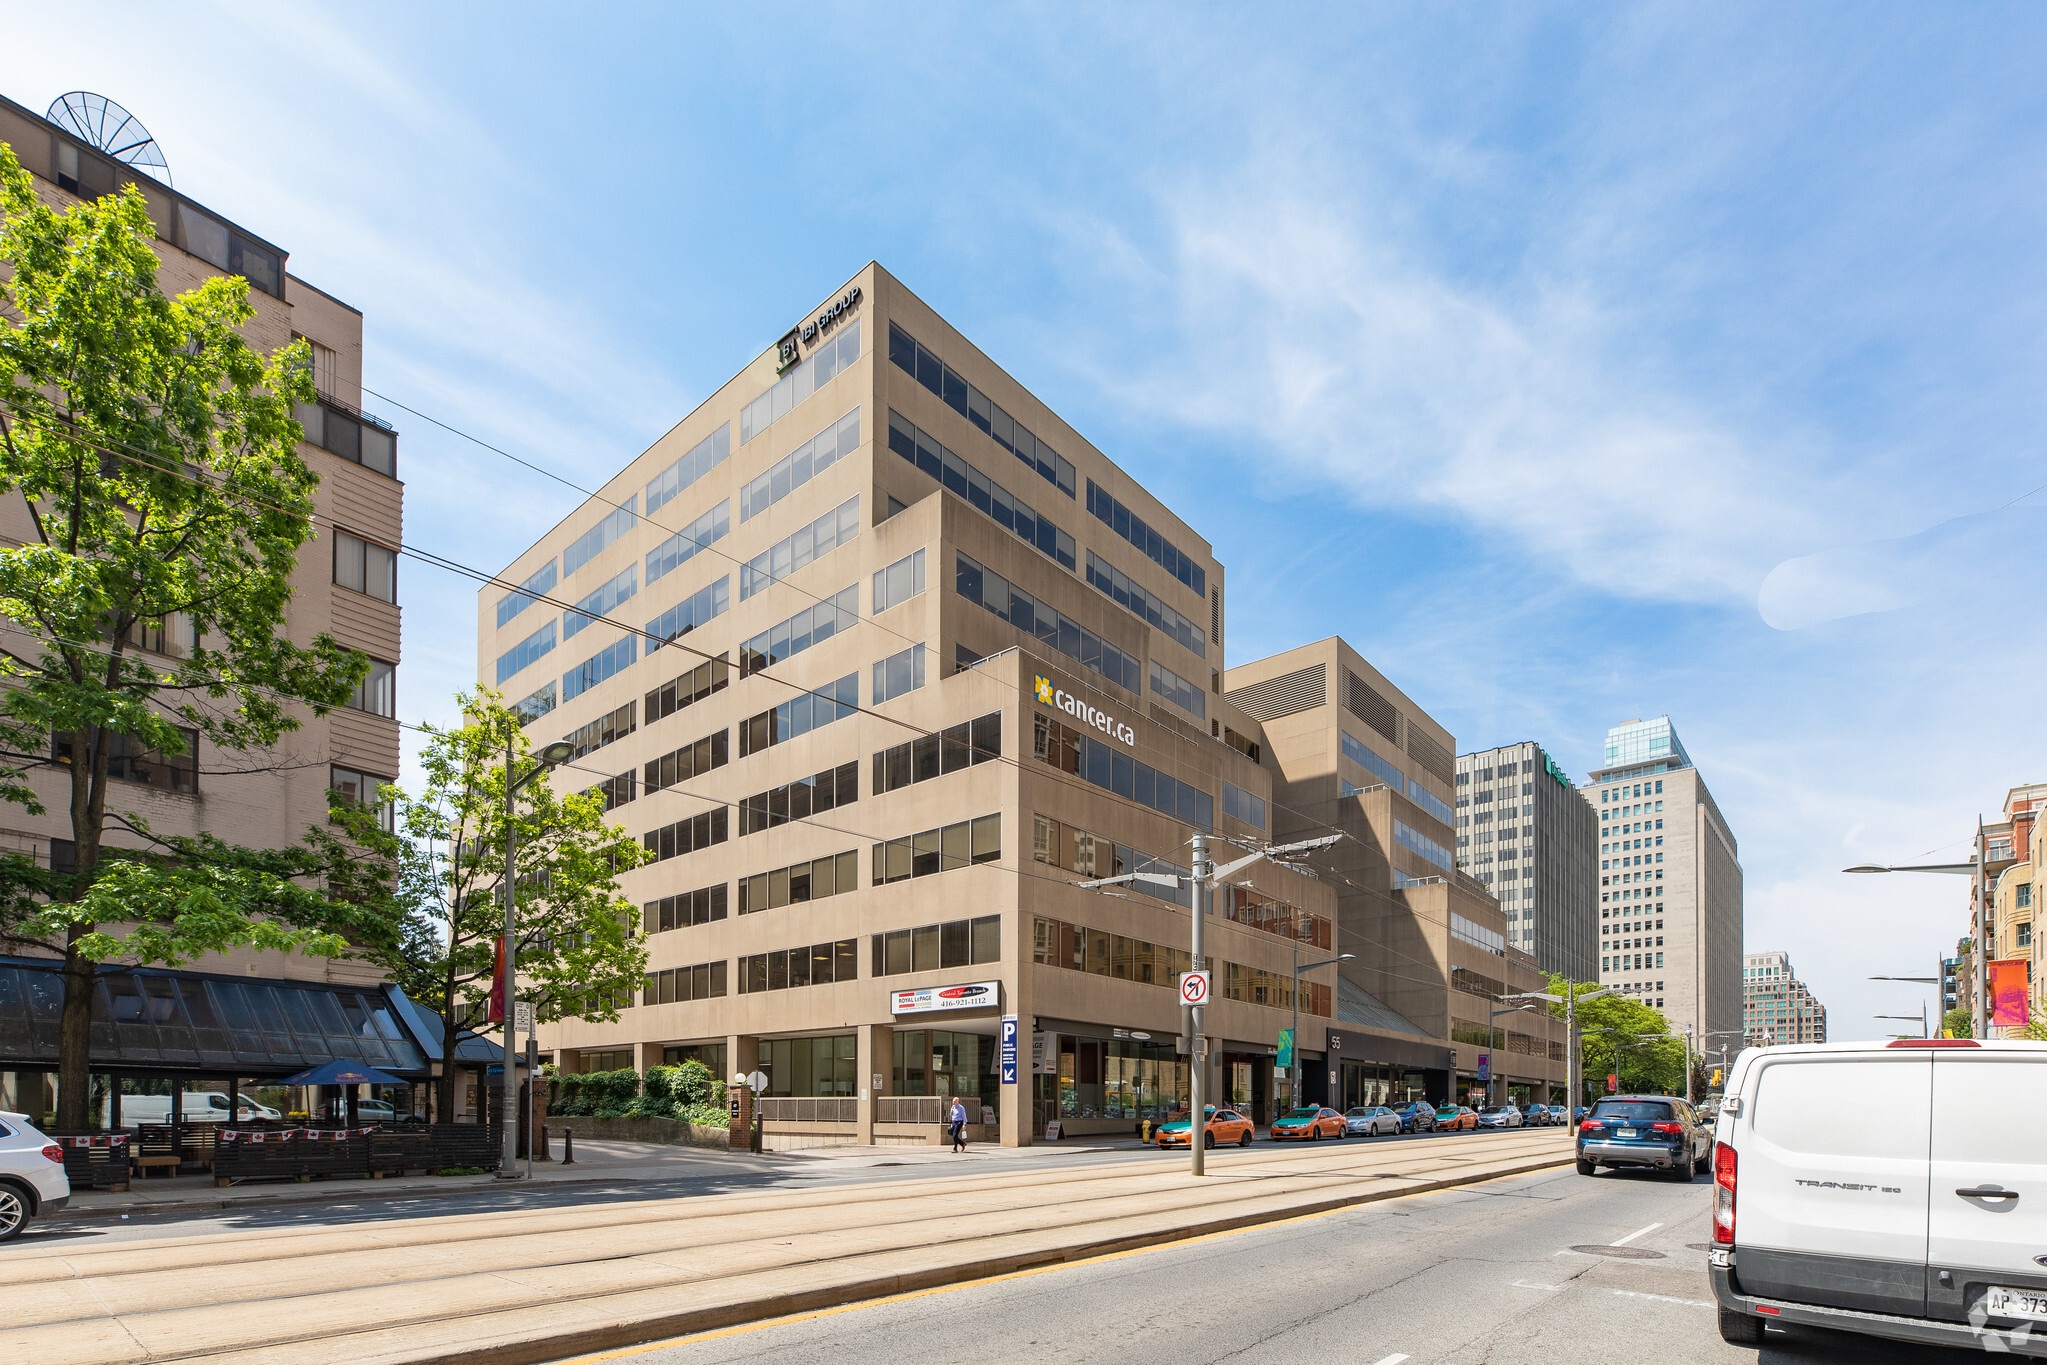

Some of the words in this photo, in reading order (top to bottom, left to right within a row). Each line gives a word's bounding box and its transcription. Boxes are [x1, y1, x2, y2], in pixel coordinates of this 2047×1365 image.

[801, 321, 817, 342] IBI
[817, 286, 860, 329] GROUP
[1055, 689, 1134, 747] cancer.ca
[941, 998, 986, 1007] 416-921-1112
[1003, 1023, 1015, 1042] P
[1795, 1179, 1878, 1191] TRANSIT
[1992, 1294, 2010, 1309] AP
[2013, 1290, 2046, 1299] ONTARIO
